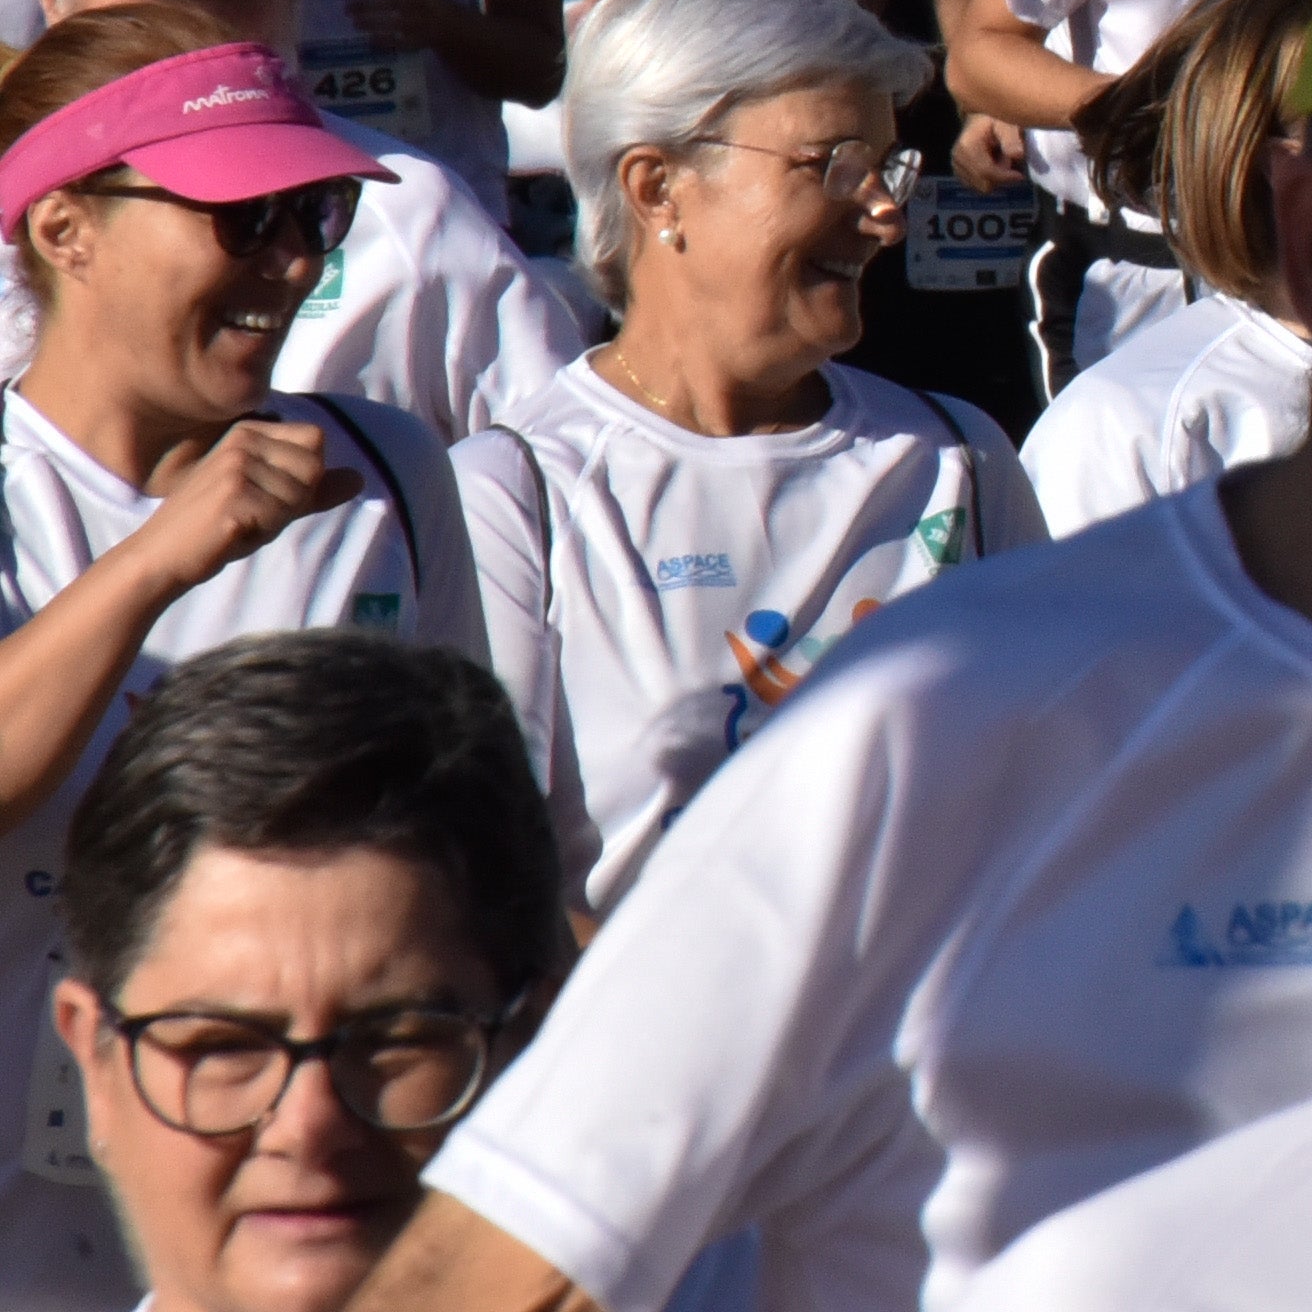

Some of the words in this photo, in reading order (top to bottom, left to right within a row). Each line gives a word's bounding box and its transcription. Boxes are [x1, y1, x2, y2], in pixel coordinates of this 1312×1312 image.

[314, 67, 396, 99] 426
[926, 214, 1034, 242] 1005
[657, 552, 731, 580] ASPACE
